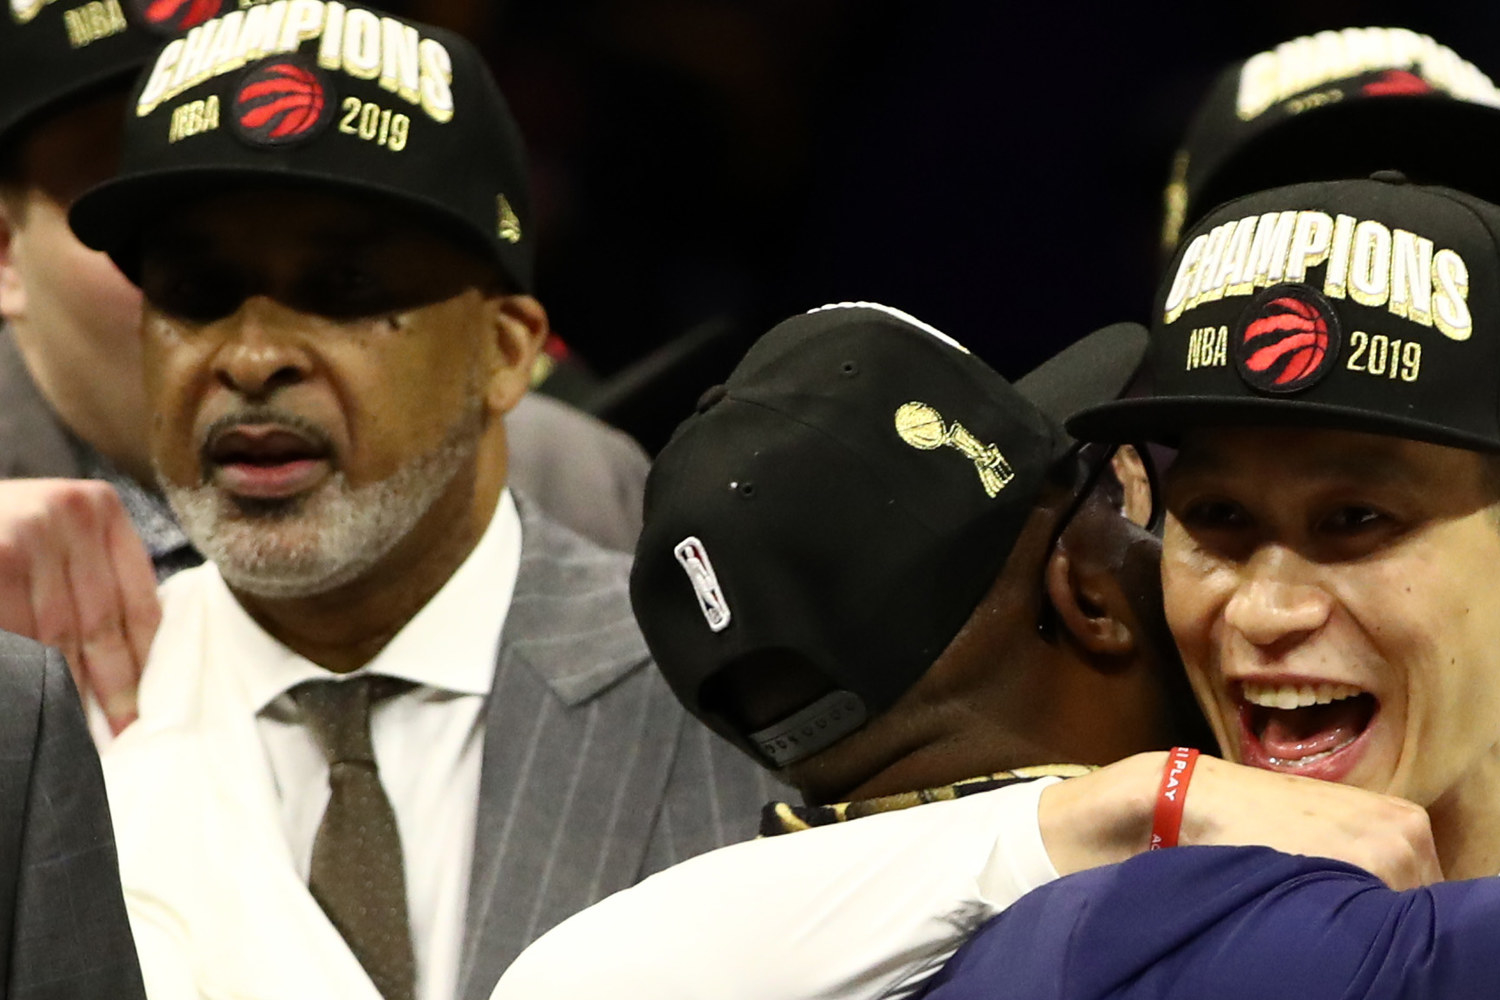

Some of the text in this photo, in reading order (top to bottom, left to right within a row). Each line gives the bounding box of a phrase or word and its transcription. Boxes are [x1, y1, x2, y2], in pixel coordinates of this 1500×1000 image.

[136, 0, 454, 123] CHAMPIONS
[169, 95, 410, 152] NBA 2019
[1163, 209, 1473, 341] CHAMPIONS
[1187, 325, 1423, 383] NBA 2019
[1164, 760, 1187, 802] PLAY
